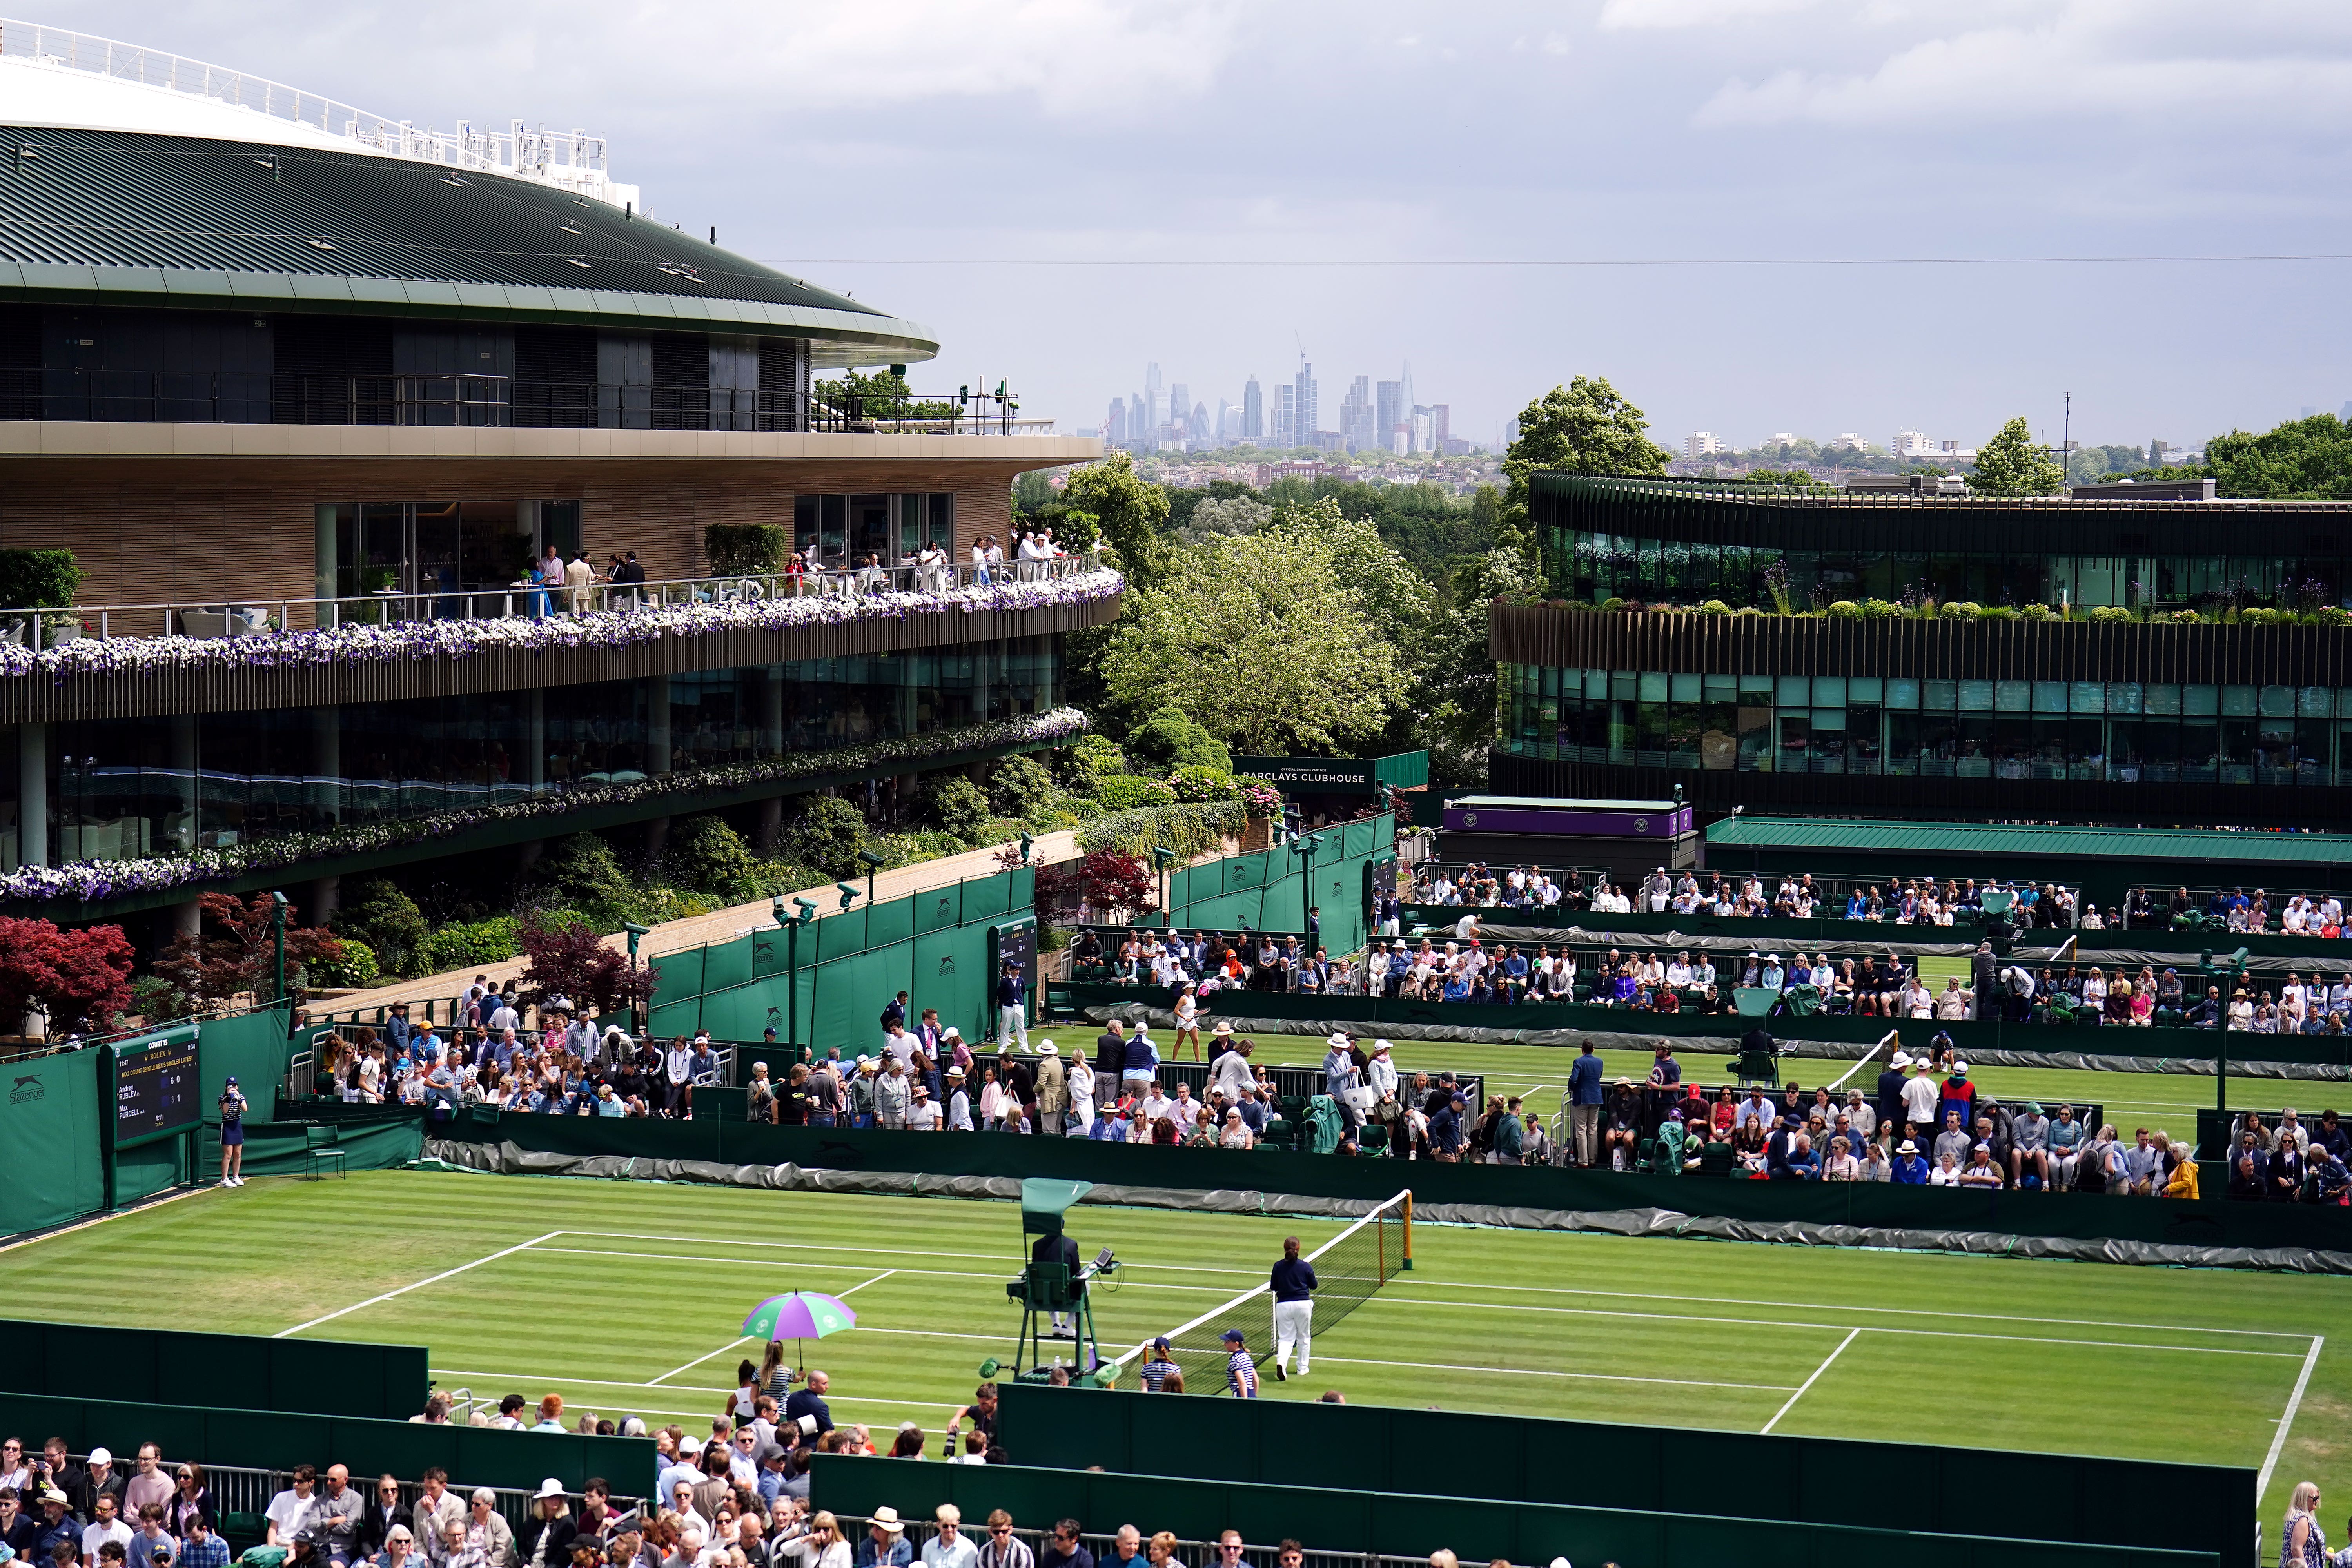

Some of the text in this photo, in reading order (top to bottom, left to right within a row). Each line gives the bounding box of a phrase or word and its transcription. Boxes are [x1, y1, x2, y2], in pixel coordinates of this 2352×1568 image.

[1301, 773, 1365, 783] CLUBHOUSE
[148, 1040, 162, 1049] COURT
[150, 1050, 166, 1060] ROLEX
[143, 1062, 166, 1073] GENTLEMEN'S
[166, 1059, 180, 1067] SINGLES
[181, 1055, 193, 1063] LATEST
[119, 1085, 133, 1093] Andrey
[10, 1089, 45, 1103] Slazenger
[119, 1090, 136, 1100] RUBLEV
[119, 1109, 140, 1119] PURCELL
